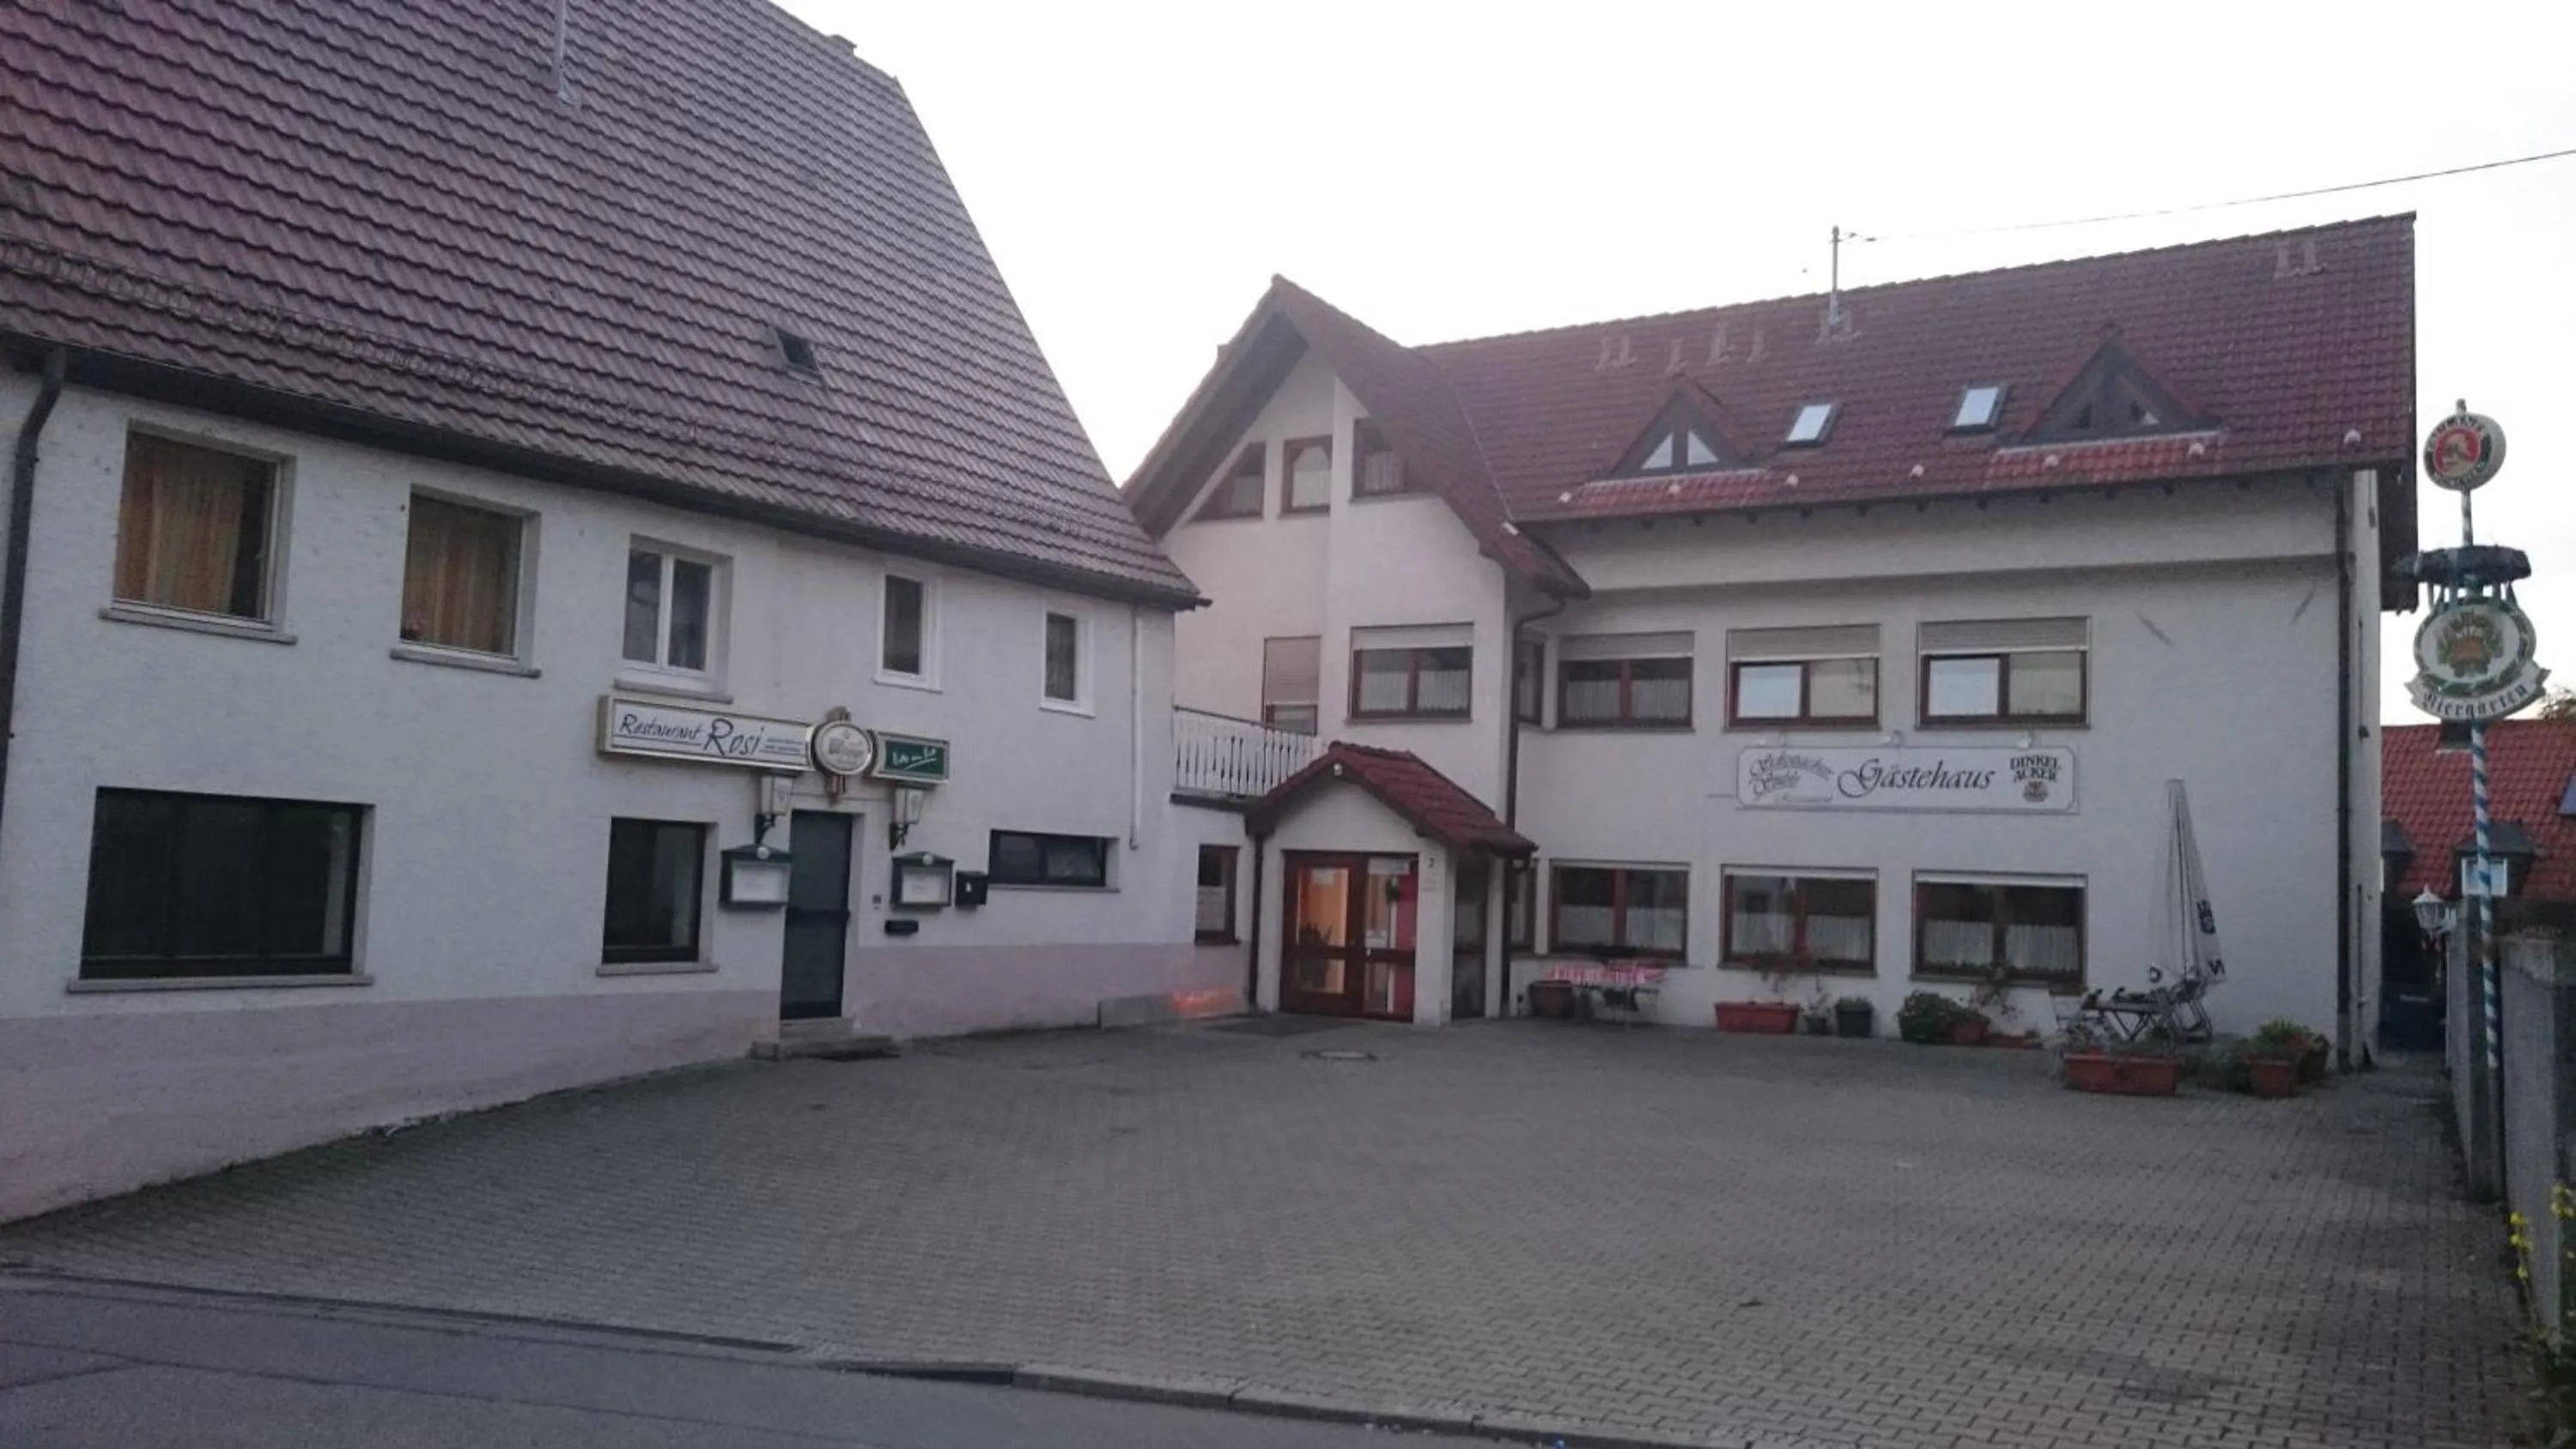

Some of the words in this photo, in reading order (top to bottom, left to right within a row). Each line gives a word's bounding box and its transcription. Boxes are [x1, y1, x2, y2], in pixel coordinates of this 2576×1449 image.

[2423, 684, 2529, 718] Biergarten
[619, 713, 702, 742] Restaurant
[703, 718, 765, 756] Rosi
[1837, 758, 1996, 799] Gästehaus
[2010, 755, 2061, 770] DINKEL
